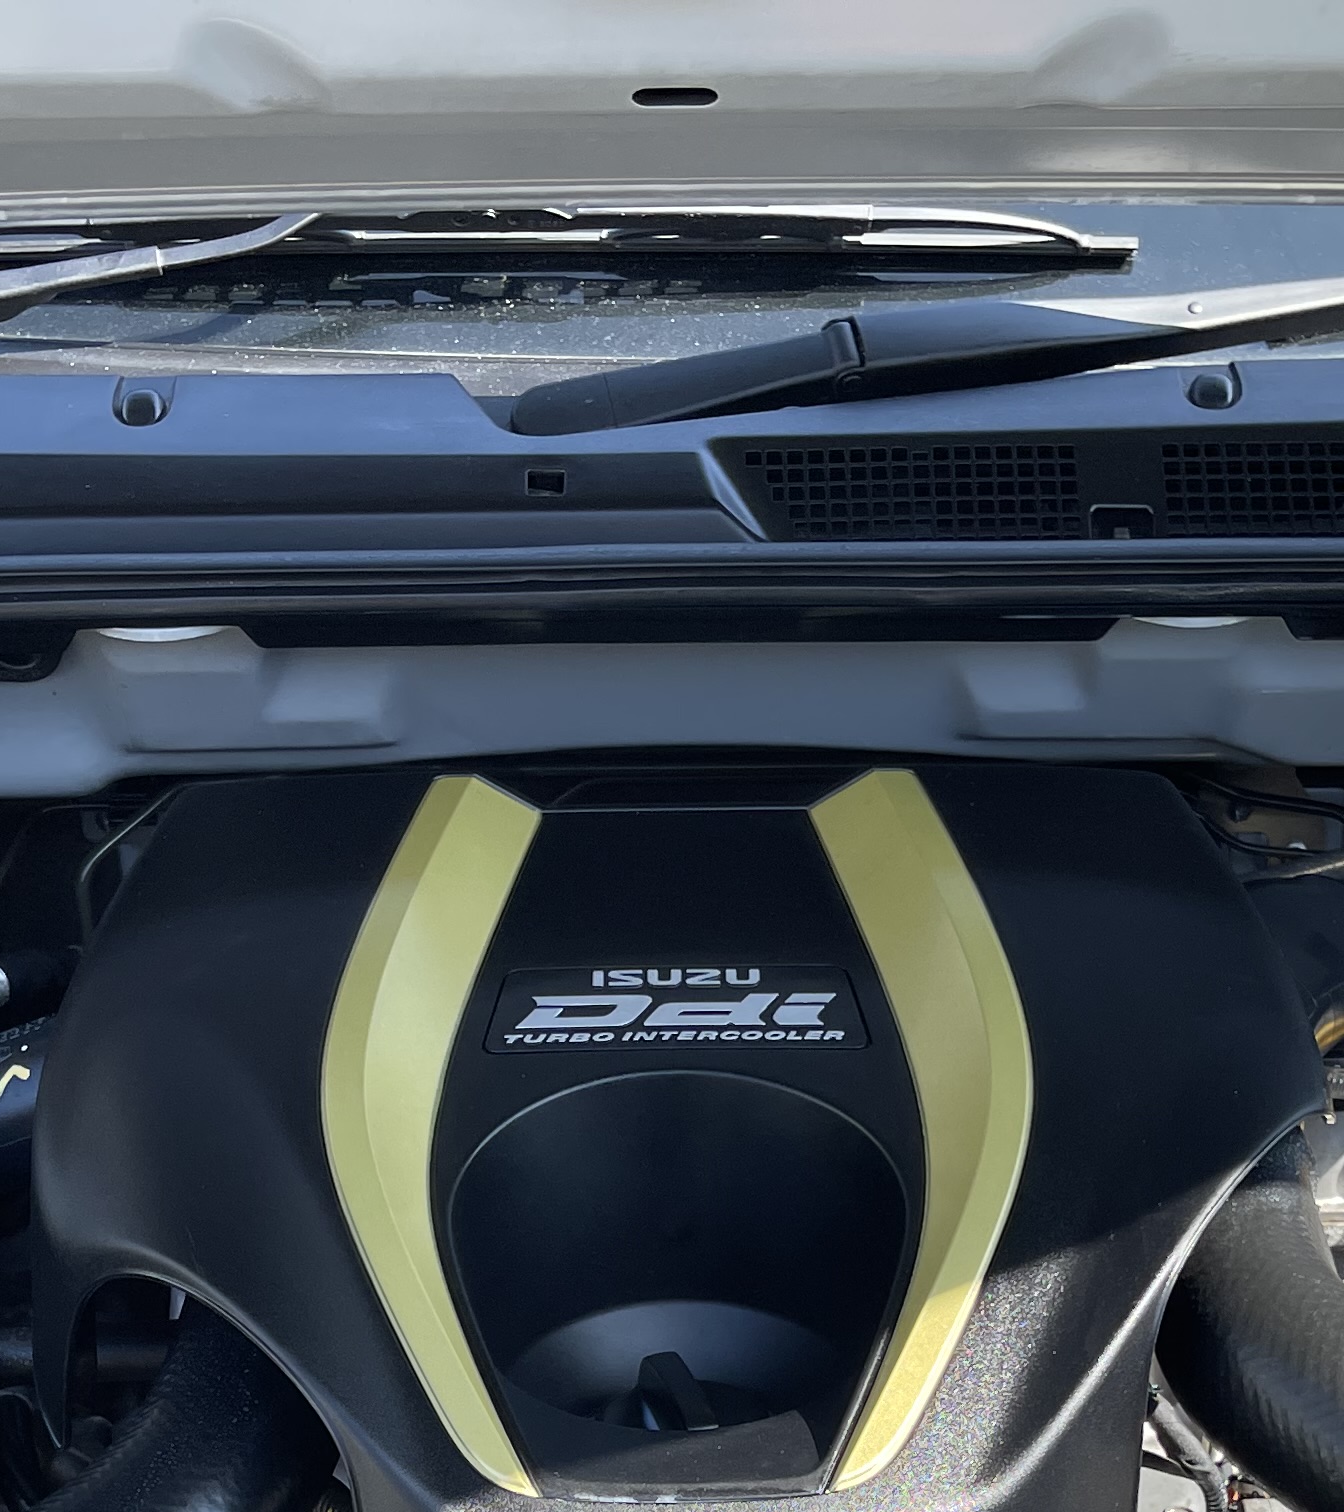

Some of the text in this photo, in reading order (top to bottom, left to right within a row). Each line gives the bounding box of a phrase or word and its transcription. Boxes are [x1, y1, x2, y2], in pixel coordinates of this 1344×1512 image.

[592, 968, 760, 988] ISUZU
[503, 1030, 846, 1044] TURBO INTERCOOLER
